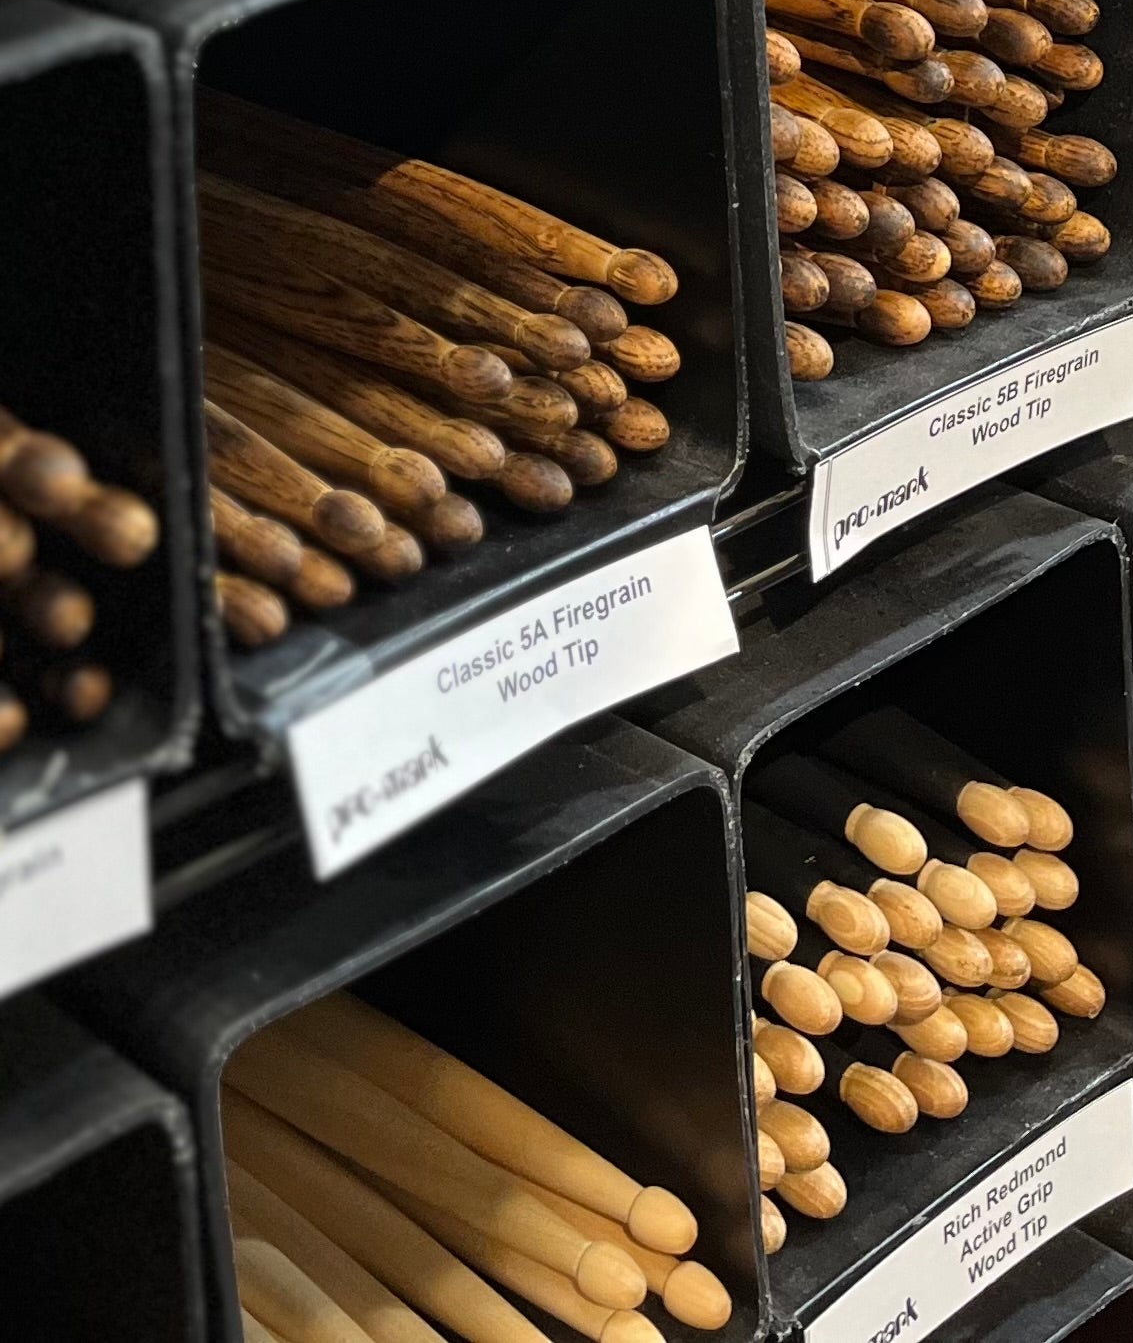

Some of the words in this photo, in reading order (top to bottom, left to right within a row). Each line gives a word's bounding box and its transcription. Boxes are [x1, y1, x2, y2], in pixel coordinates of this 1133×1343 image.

[929, 395, 992, 438] Classic
[997, 380, 1018, 407] 5B
[1023, 347, 1100, 394] Firegrain
[971, 405, 1021, 447] Wood
[1025, 395, 1052, 419] Tip
[436, 639, 514, 695] Classic
[519, 618, 550, 652] 5A
[551, 572, 654, 636] Firegrain
[496, 651, 559, 705] Wood
[562, 635, 601, 668] Tip
[942, 1202, 981, 1245] Rich
[986, 1136, 1068, 1211] Redmond
[960, 1211, 1012, 1264] Active
[1017, 1179, 1054, 1216] Grip
[967, 1233, 1017, 1286] Wood
[1020, 1214, 1048, 1245] Tip
